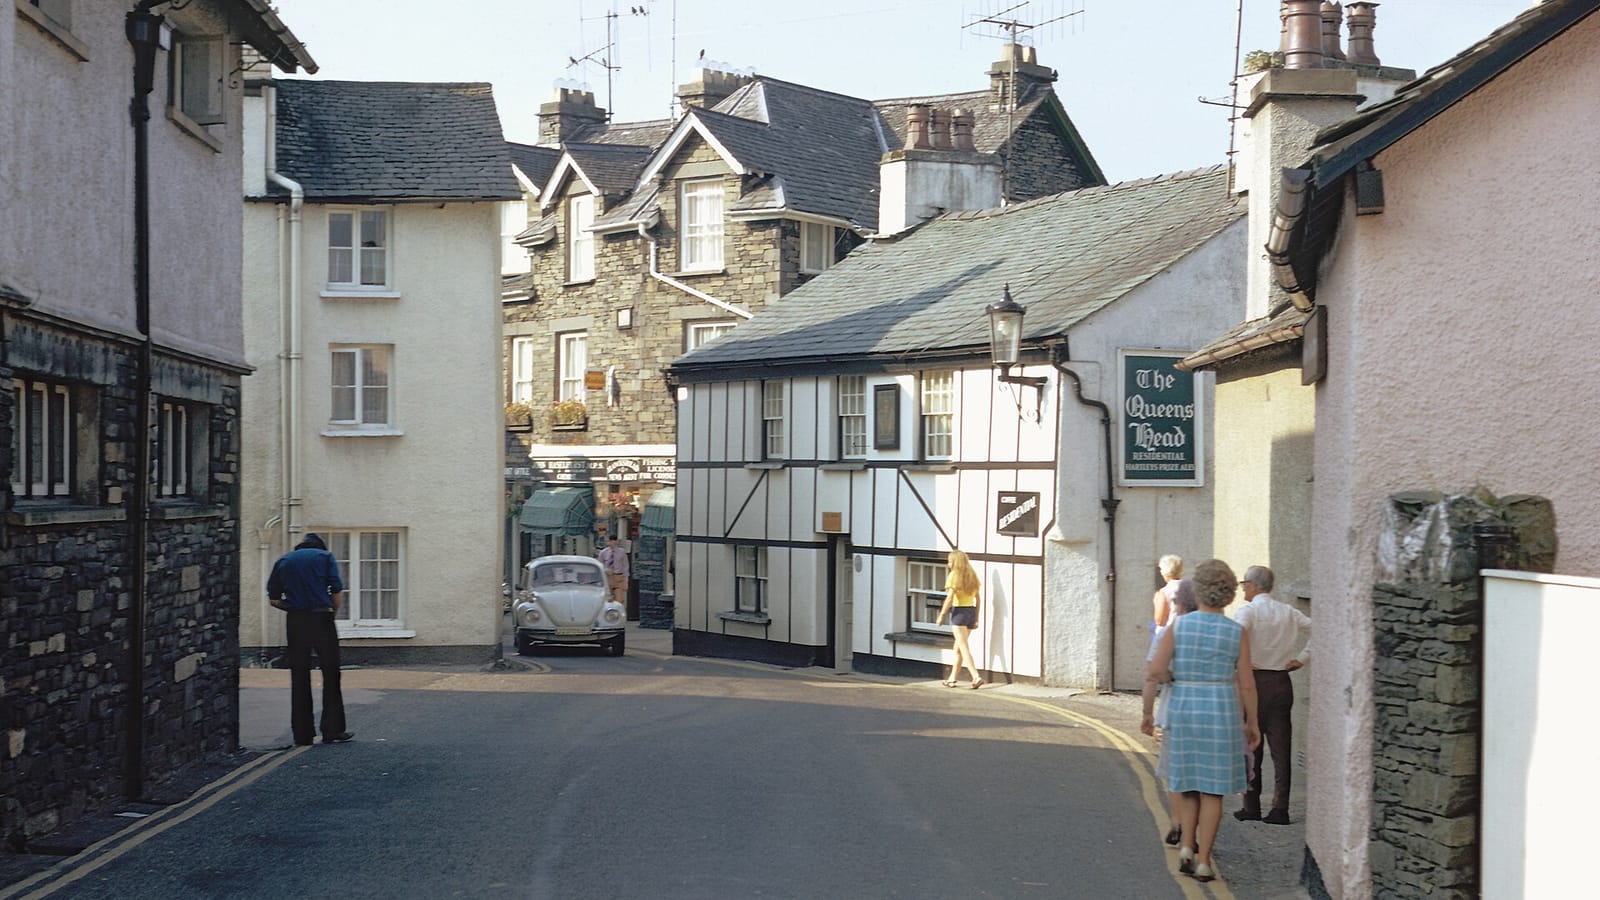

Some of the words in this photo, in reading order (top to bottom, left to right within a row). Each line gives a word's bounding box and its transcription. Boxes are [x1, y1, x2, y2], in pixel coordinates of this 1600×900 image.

[1136, 369, 1175, 392] The
[1126, 394, 1194, 421] Queens
[1128, 422, 1185, 451] Head
[1132, 452, 1186, 460] RESIDENTIAL
